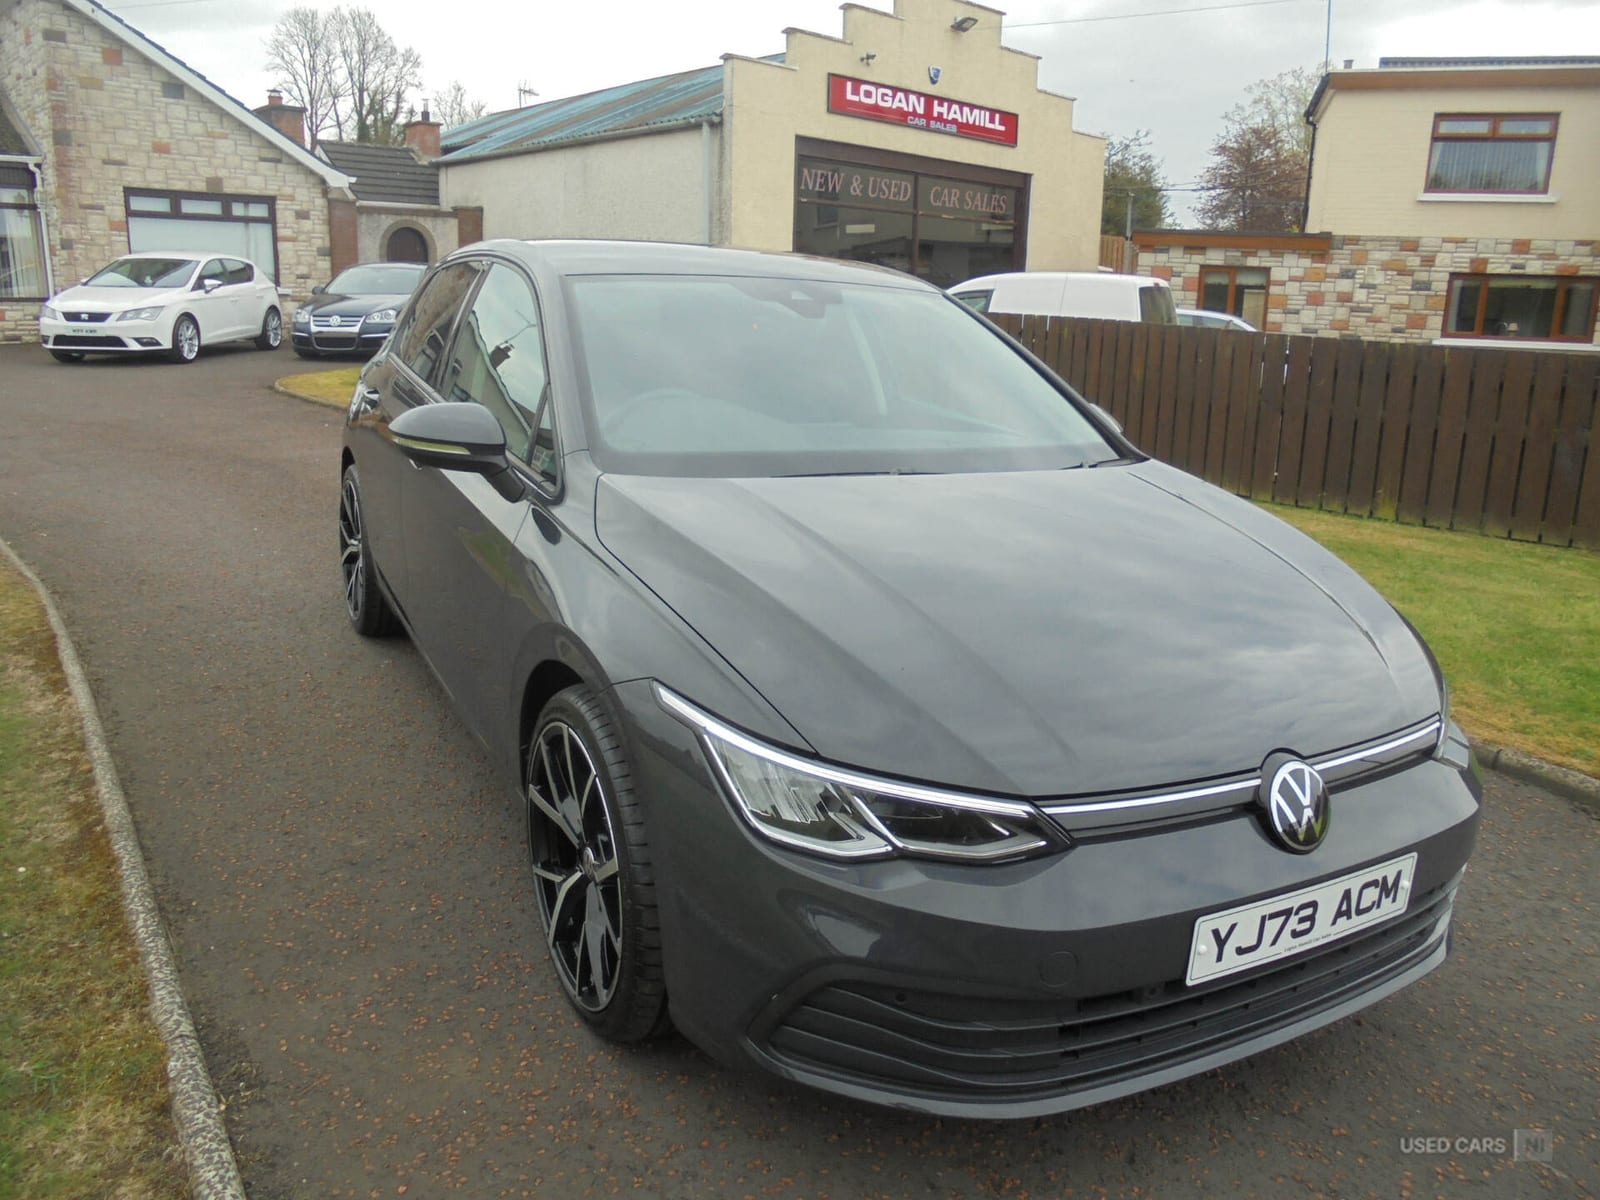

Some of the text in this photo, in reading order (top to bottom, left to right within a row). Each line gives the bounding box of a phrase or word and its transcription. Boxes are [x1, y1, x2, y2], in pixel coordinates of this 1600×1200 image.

[846, 81, 1006, 132] LOGAN HAMILL
[907, 115, 957, 133] CAR SALES
[800, 167, 912, 202] NEW & USED
[930, 186, 1008, 214] CAR SALES
[1211, 869, 1403, 964] YJ73 ACM
